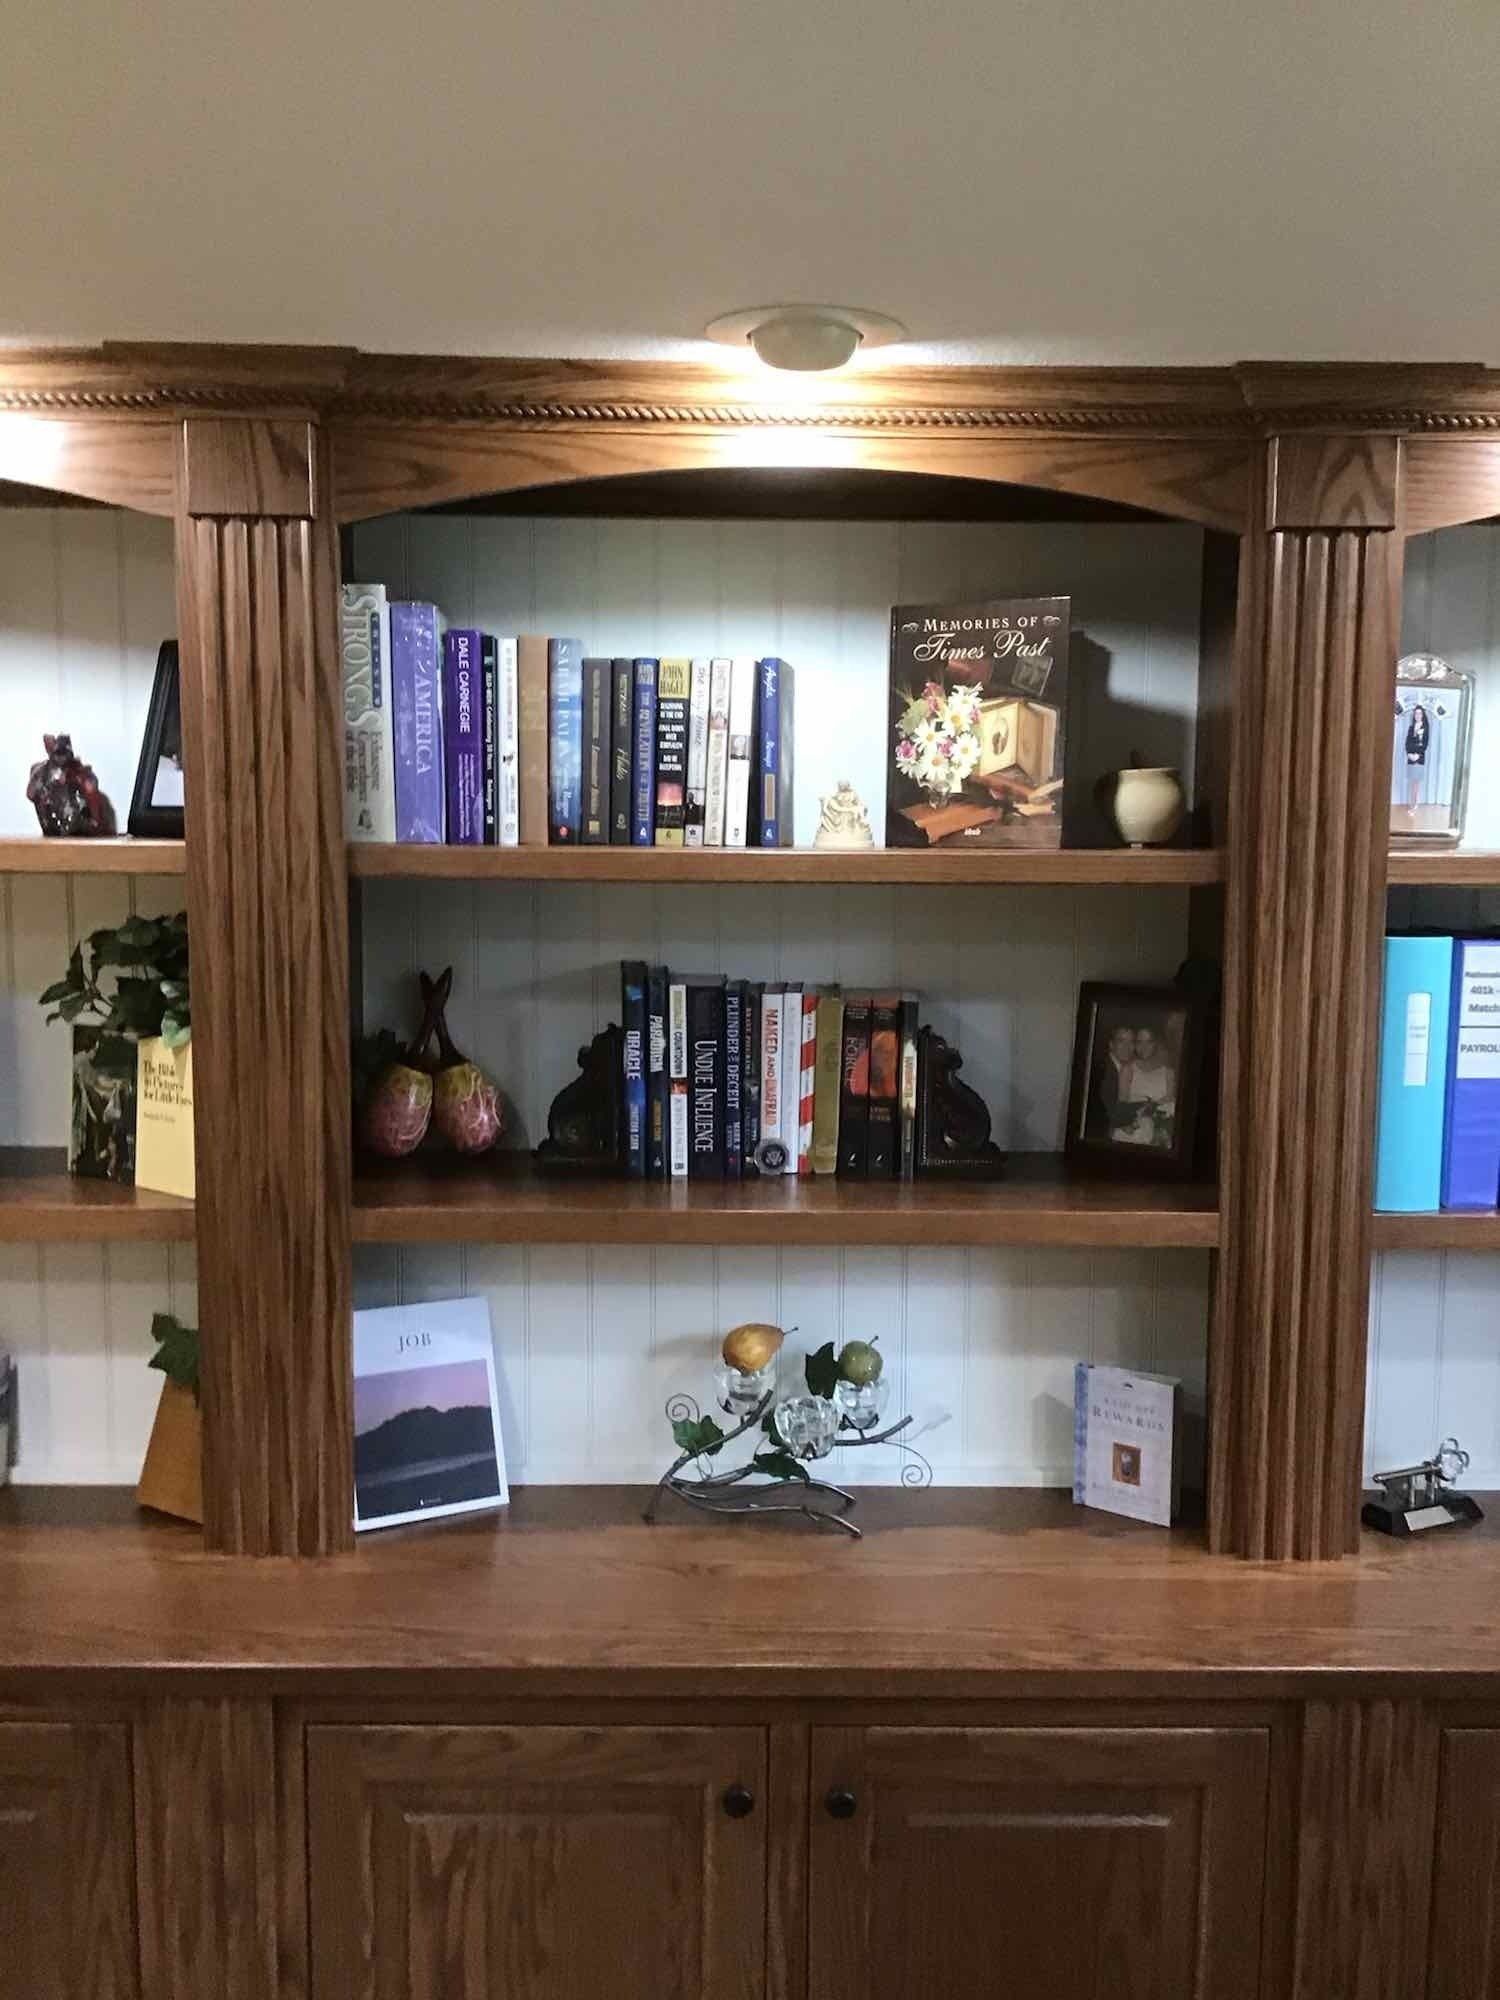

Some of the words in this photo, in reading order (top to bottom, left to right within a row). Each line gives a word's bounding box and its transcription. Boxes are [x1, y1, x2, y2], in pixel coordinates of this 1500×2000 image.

[912, 633, 985, 662] Times
[992, 630, 1053, 659] Past
[922, 617, 1010, 633] MEMORIES
[1016, 616, 1039, 629] OF
[343, 594, 383, 729] STRONG'S
[458, 637, 469, 669] DALE
[557, 641, 571, 703] SARAH
[415, 672, 433, 775] AMERICA
[458, 672, 471, 734] CARNEGIE
[649, 1014, 664, 1073] PARADIGM
[727, 996, 739, 1054] PLUNDER
[764, 1007, 779, 1054] NAKED
[626, 1030, 641, 1080] ORACLE
[694, 1039, 717, 1084] UNDUE
[766, 1055, 775, 1078] AND
[727, 1064, 739, 1110] DECEIT
[694, 1087, 717, 1153] INFLUENCE
[397, 1332, 432, 1353] JOB
